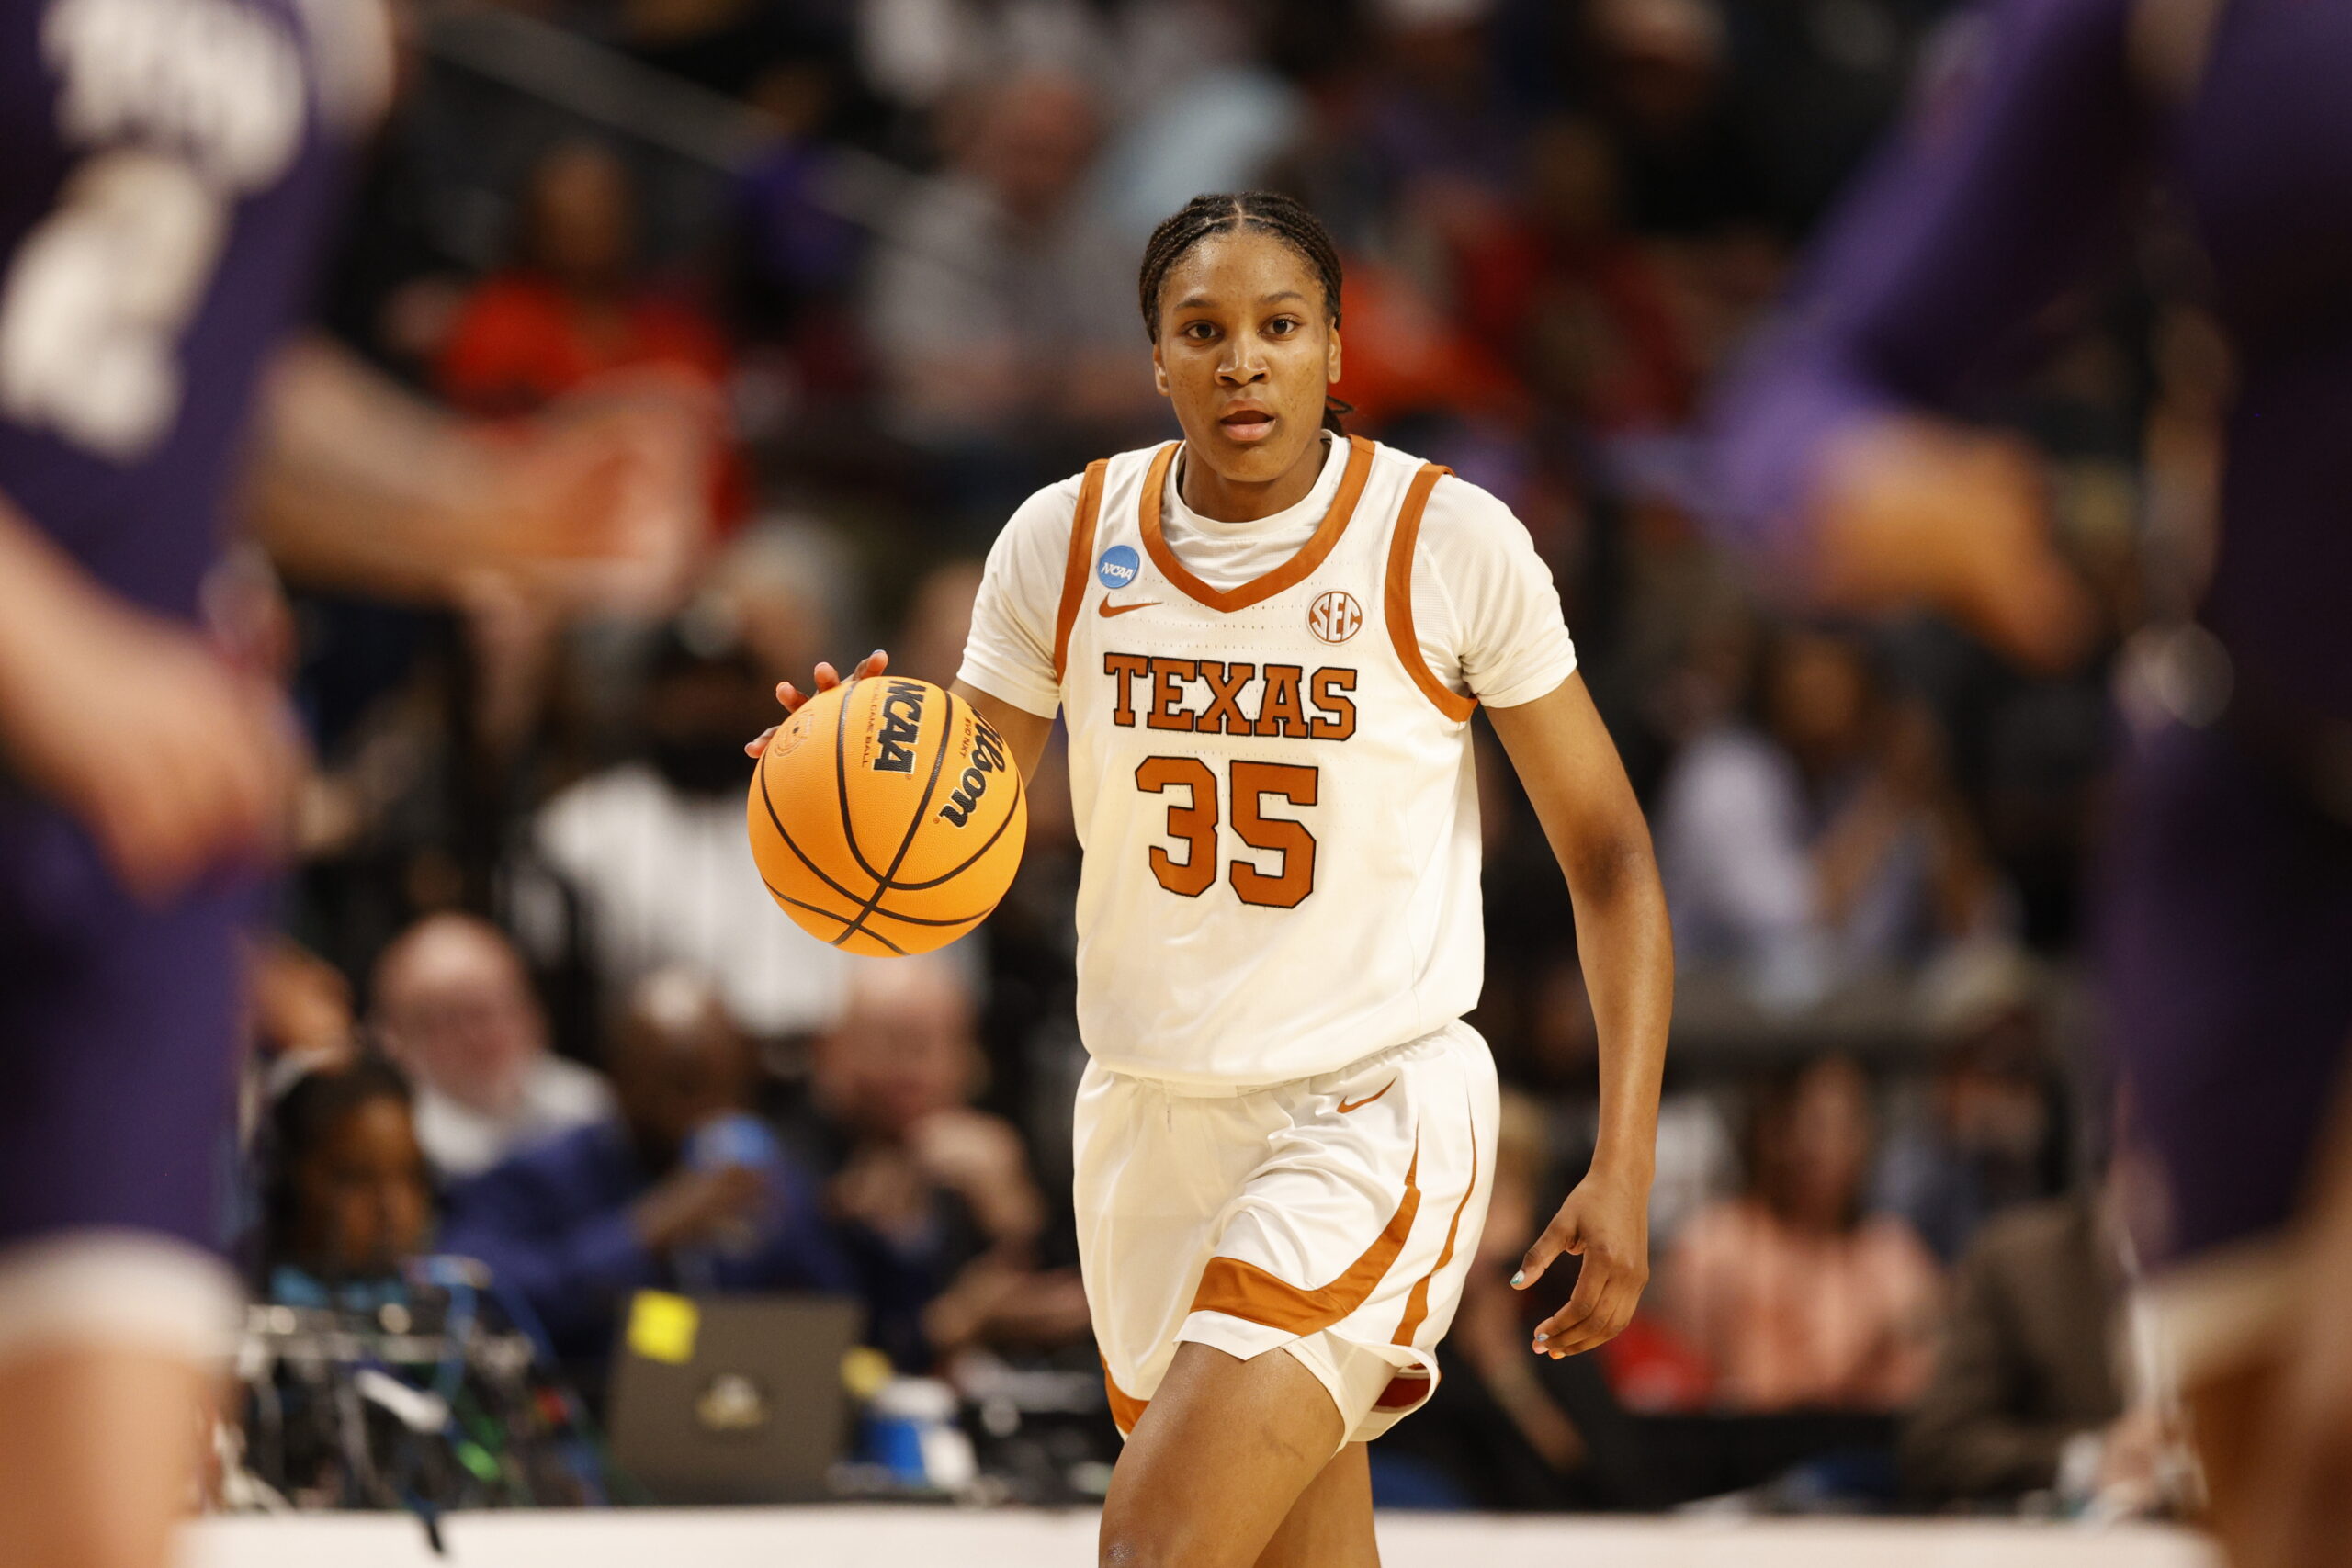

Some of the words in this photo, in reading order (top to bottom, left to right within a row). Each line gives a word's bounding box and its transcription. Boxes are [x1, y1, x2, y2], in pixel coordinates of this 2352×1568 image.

[1101, 562, 1134, 581] NCAA
[1310, 592, 1362, 642] SEC
[872, 680, 927, 774] NCAA
[1103, 652, 1358, 741] TEXAS
[862, 736, 872, 768] BALL
[1135, 755, 1319, 909] 35
